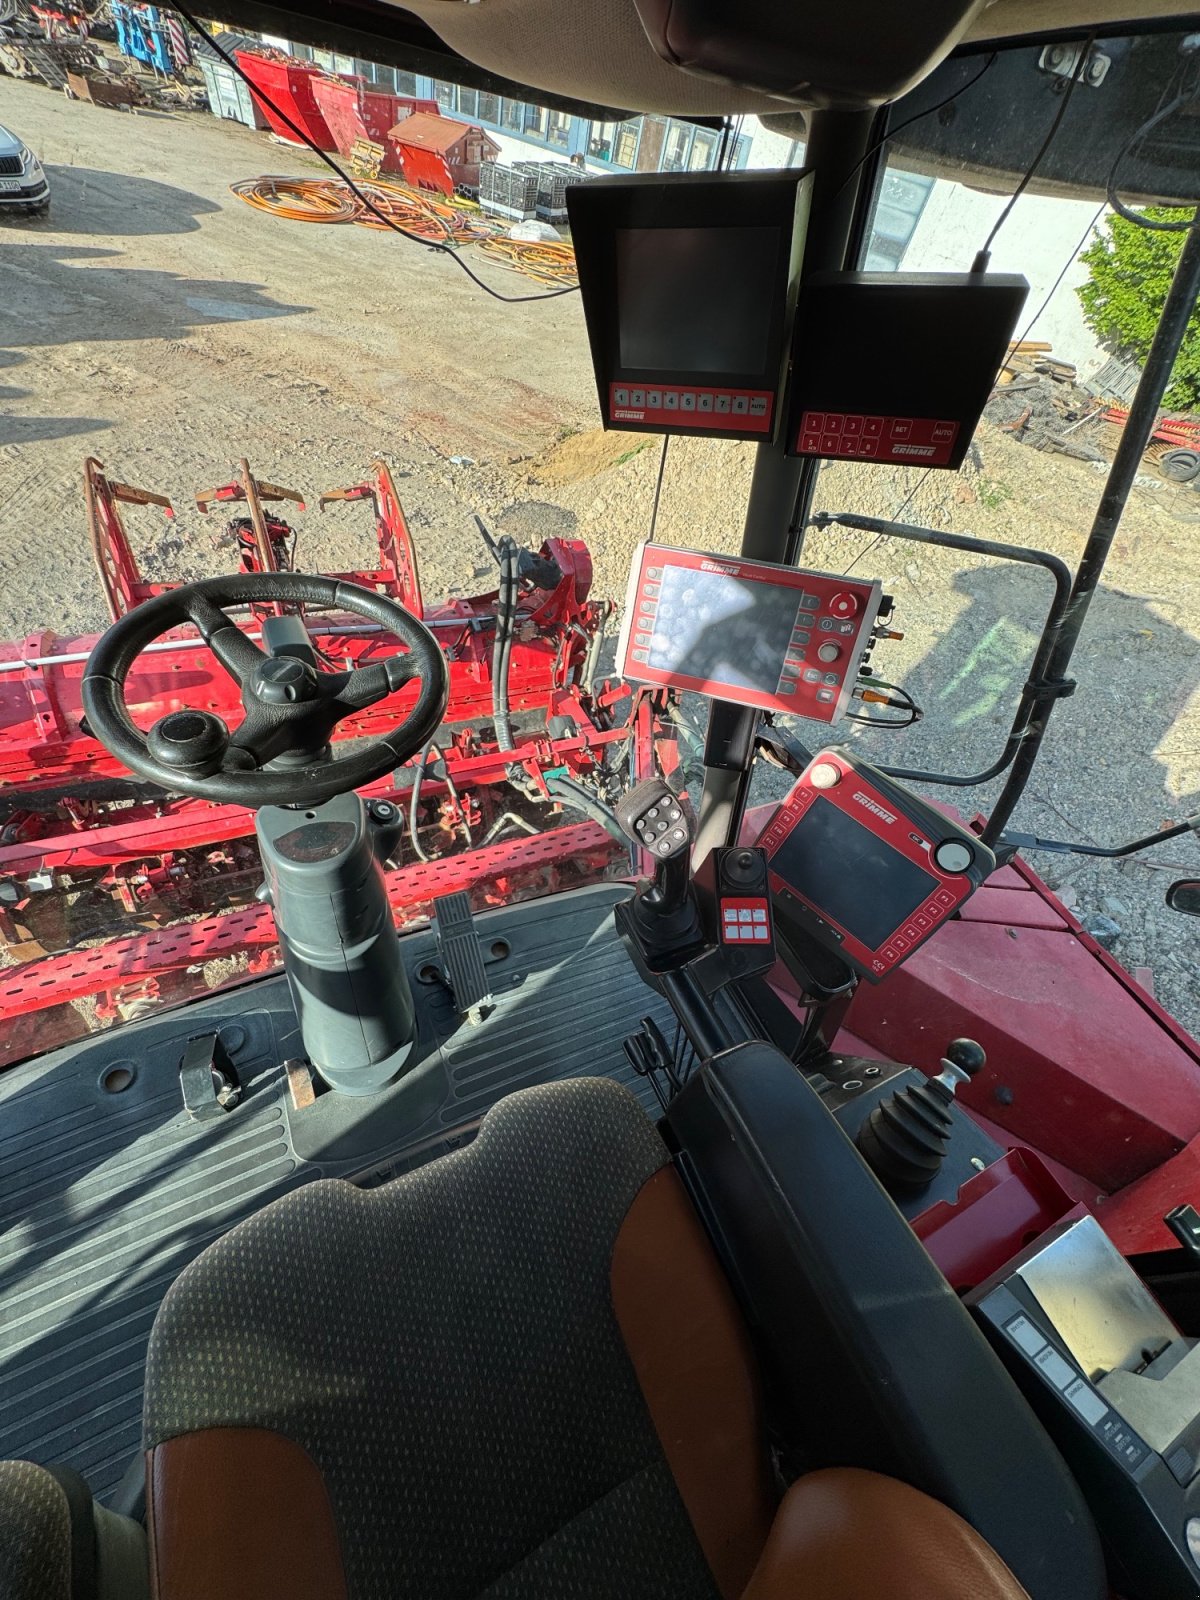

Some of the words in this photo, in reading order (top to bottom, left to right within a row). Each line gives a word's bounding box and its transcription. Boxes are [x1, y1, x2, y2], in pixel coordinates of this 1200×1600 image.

[614, 410, 645, 420] GRIMME
[892, 444, 936, 457] GRIMME
[700, 561, 741, 576] GRIMME
[852, 791, 898, 825] GRIMME
